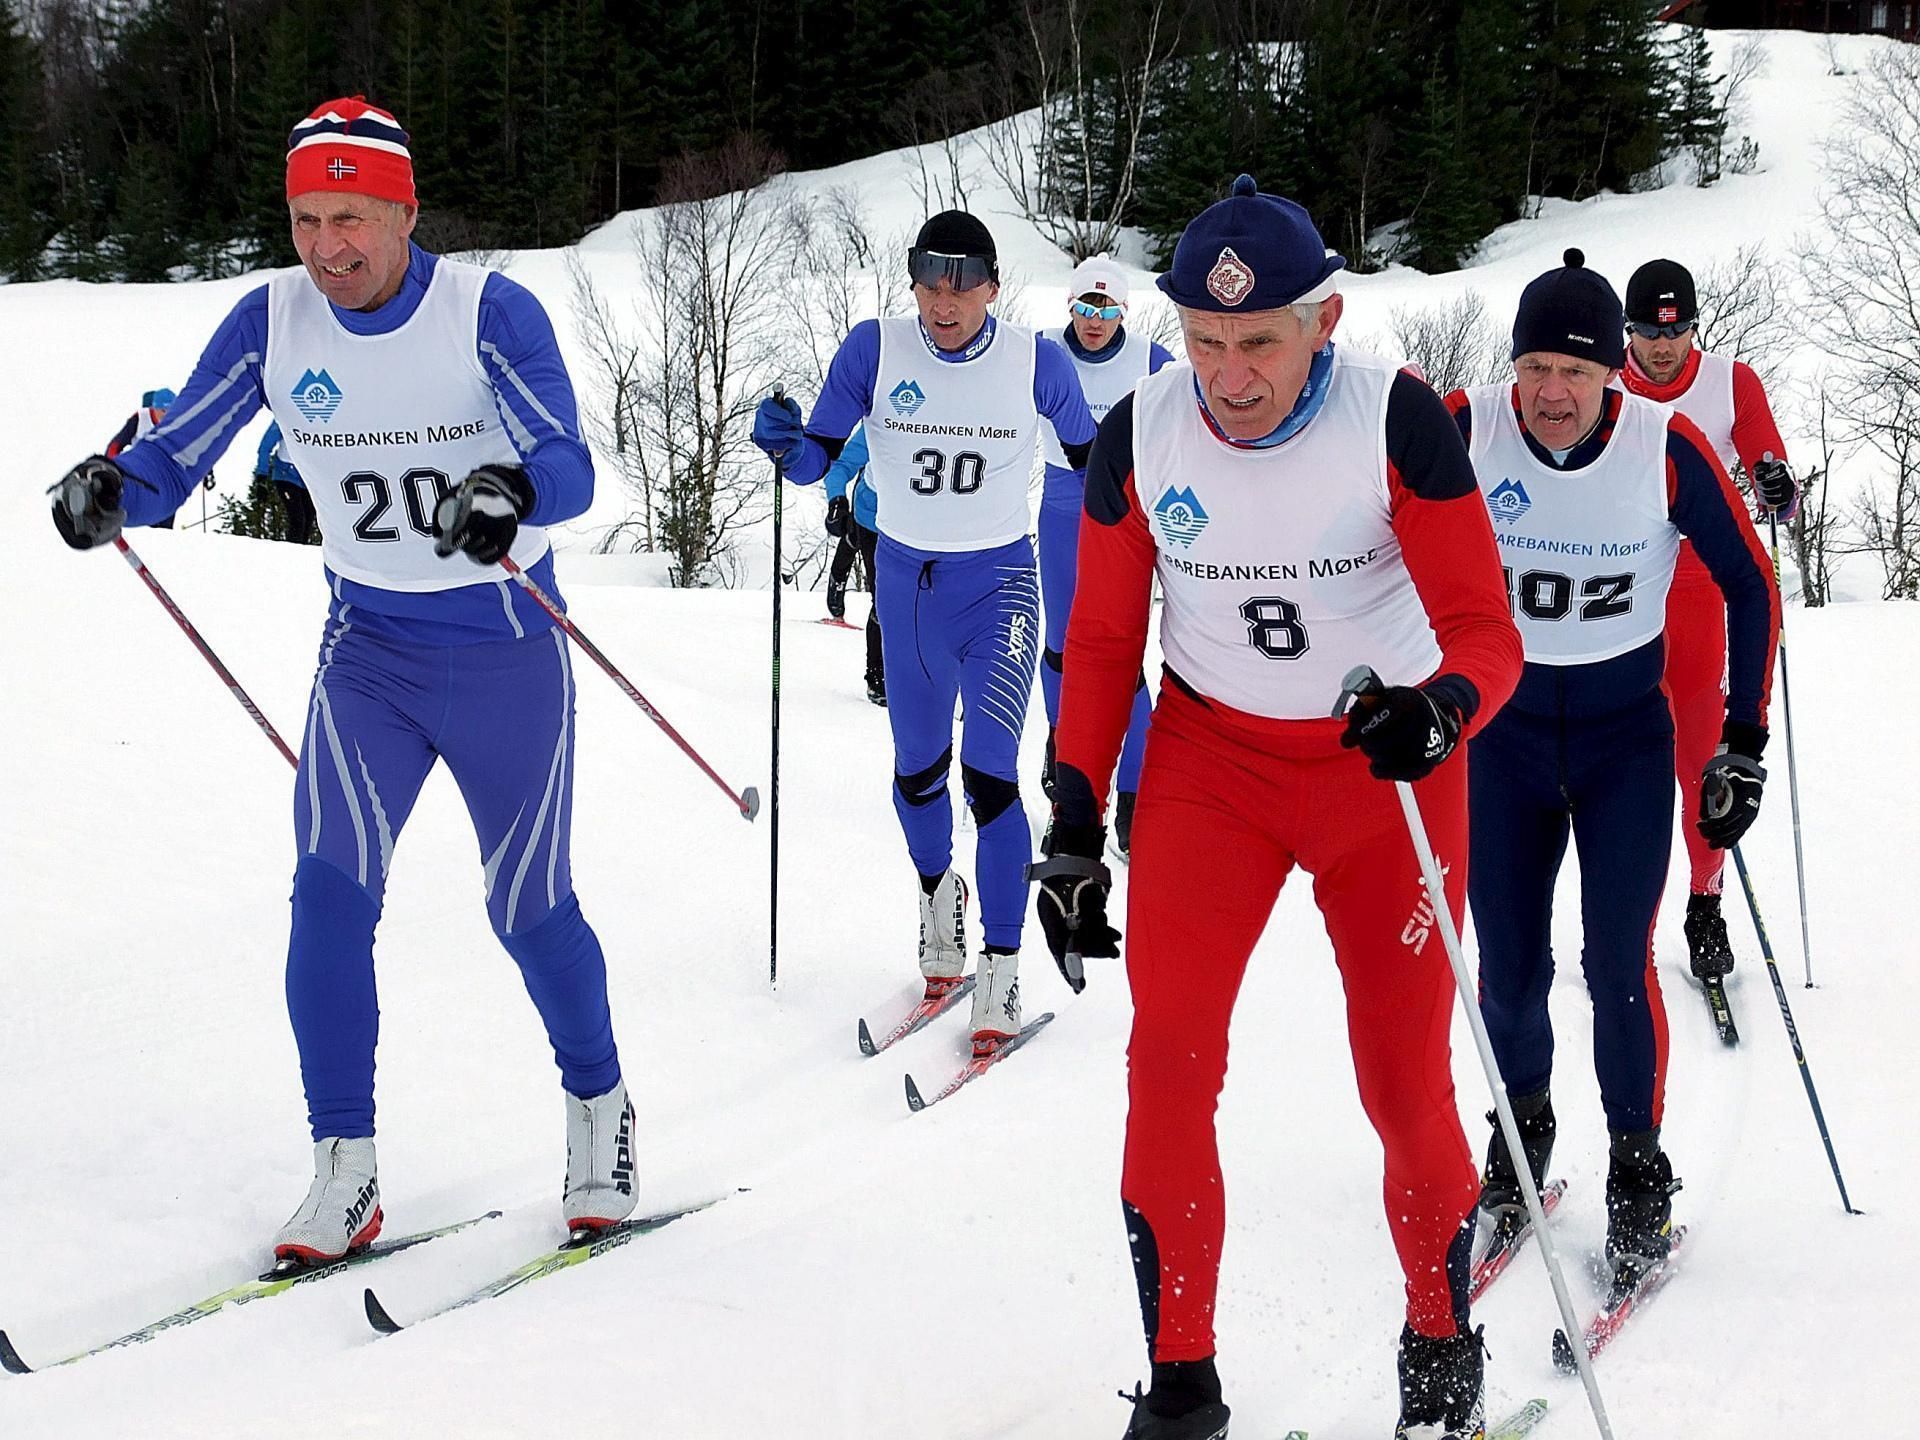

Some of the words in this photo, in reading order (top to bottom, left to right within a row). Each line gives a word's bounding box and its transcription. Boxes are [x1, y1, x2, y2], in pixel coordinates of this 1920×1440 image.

[292, 427, 418, 447] SPAREBANKEN
[427, 419, 486, 445] MØRE
[884, 417, 974, 437] SPAREBANKEN
[979, 426, 1018, 439] MØRE
[910, 447, 987, 496] 30
[340, 466, 451, 543] 20
[1164, 554, 1298, 580] PAREBANKEN
[1308, 548, 1378, 579] MØRE
[1494, 532, 1593, 556] AREBANKEN
[1601, 539, 1649, 557] MØRE
[1238, 596, 1311, 660] 8
[344, 1176, 377, 1241] alpin
